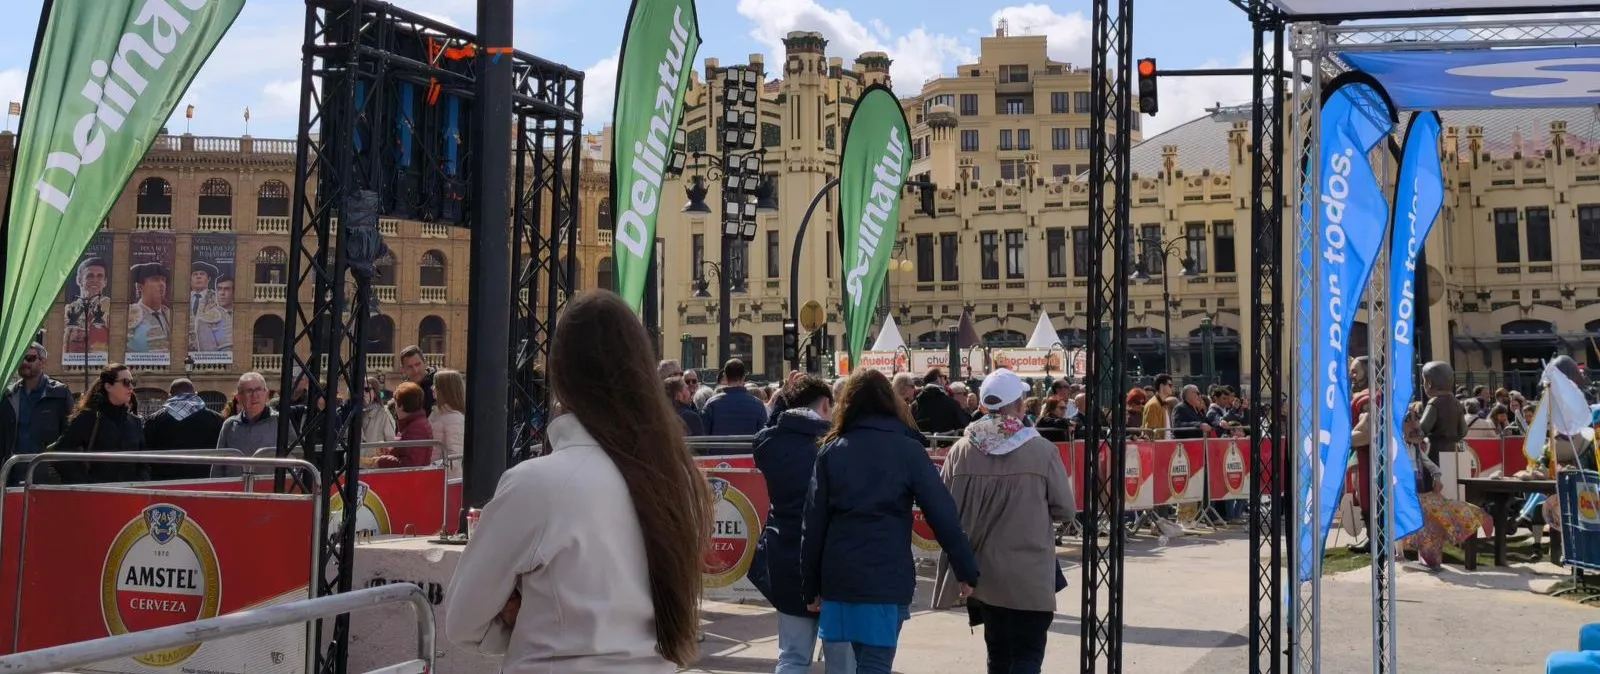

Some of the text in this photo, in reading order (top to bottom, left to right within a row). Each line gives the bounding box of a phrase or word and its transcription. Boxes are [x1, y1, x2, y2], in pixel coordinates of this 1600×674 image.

[35, 0, 207, 213] Delina
[615, 6, 689, 259] Delinatur
[1321, 148, 1354, 265] todos.
[1394, 176, 1419, 345] por todo
[860, 356, 895, 366] ñuelos
[125, 566, 197, 589] AMSTEL
[130, 597, 186, 613] CERVEZA
